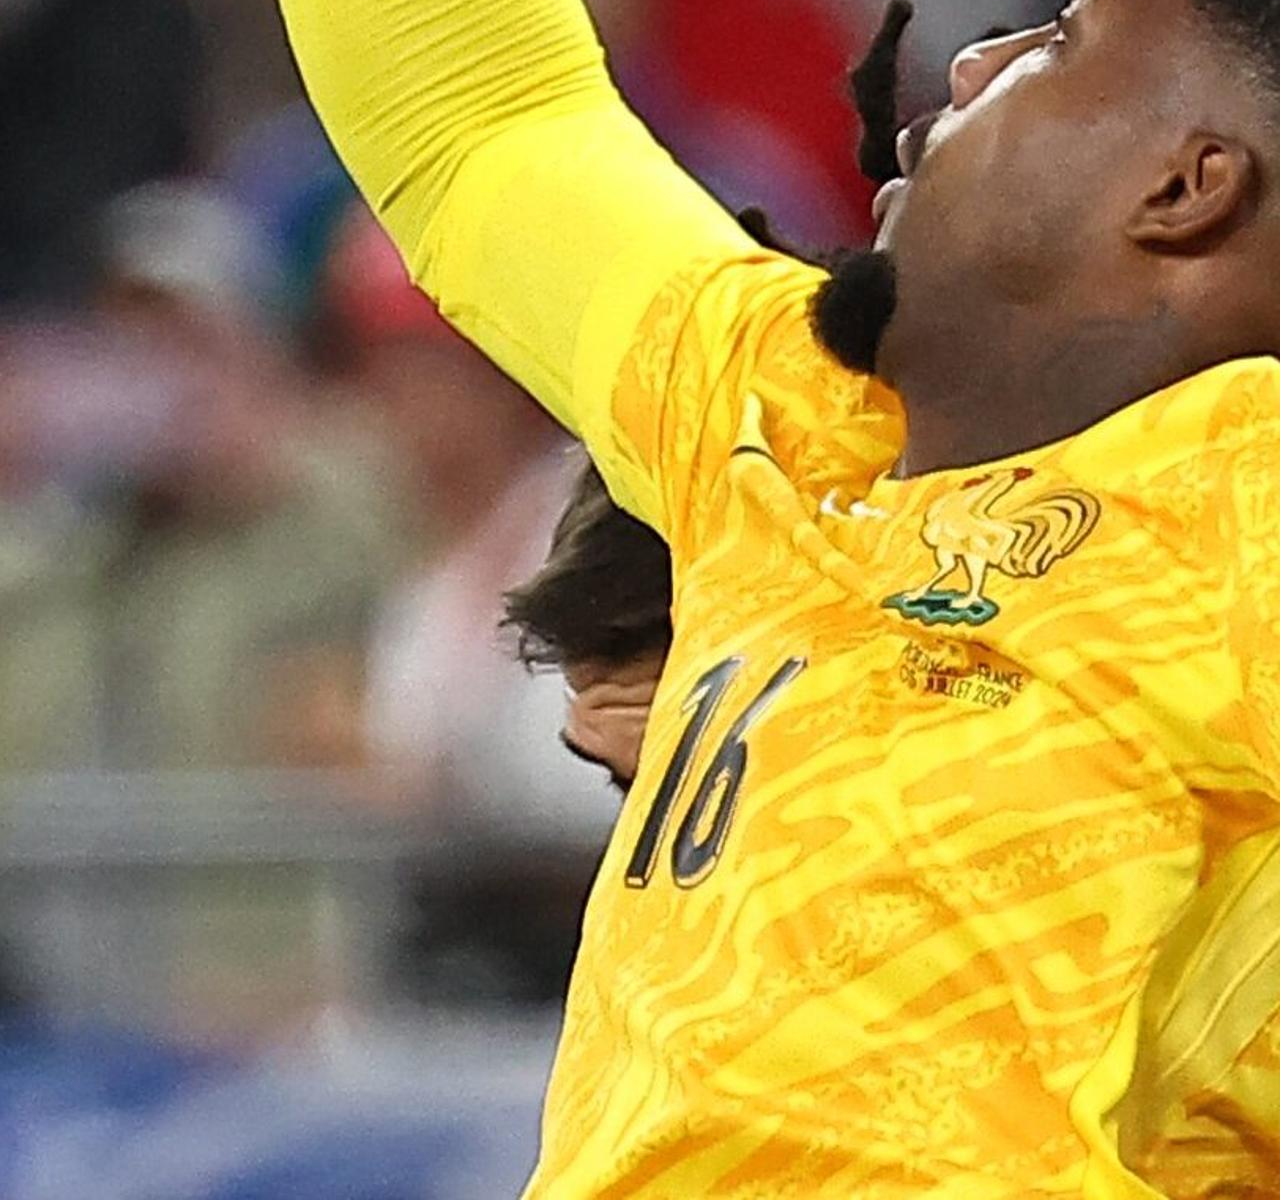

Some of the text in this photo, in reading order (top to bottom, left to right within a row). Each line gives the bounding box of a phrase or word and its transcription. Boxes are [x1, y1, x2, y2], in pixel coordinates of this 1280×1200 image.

[976, 661, 1024, 693] FRANCE
[972, 684, 1013, 709] 2024
[624, 654, 808, 890] 16
